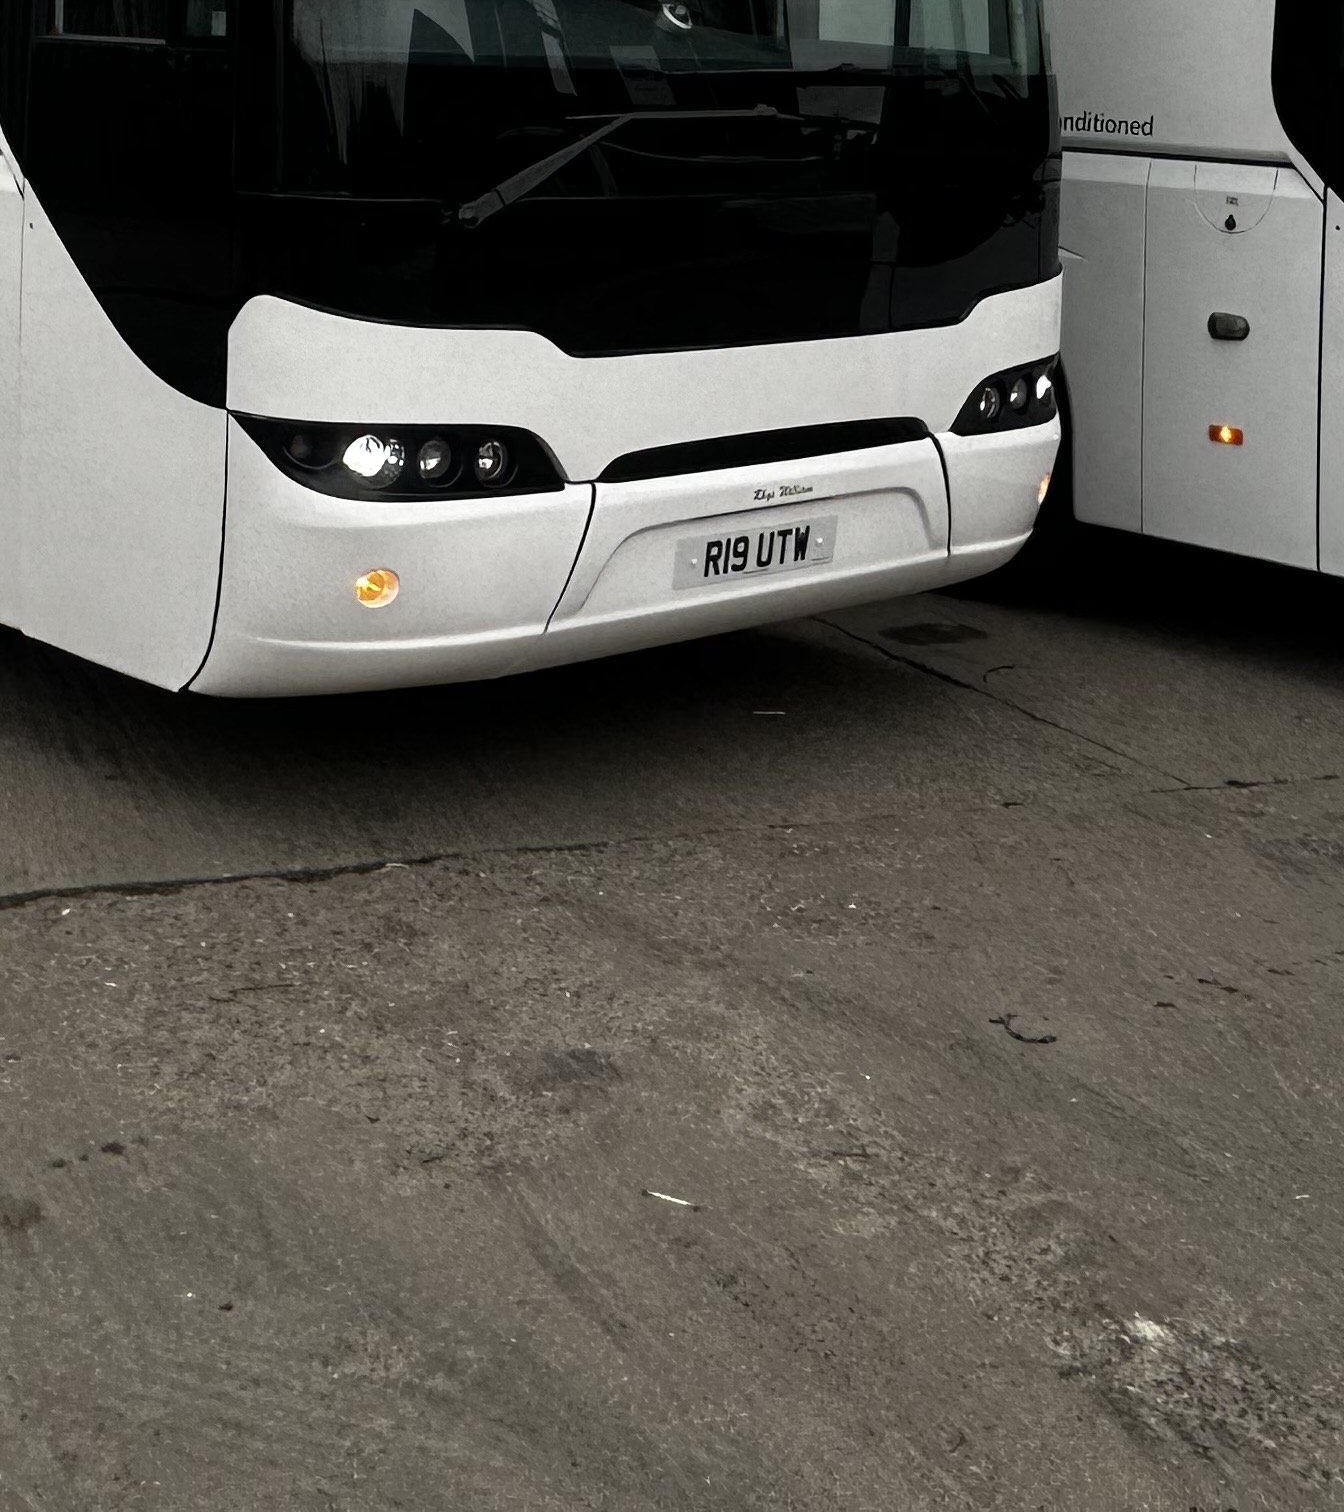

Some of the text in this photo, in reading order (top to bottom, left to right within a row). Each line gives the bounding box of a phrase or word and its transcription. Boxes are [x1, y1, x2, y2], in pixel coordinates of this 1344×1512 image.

[1059, 110, 1154, 137] nditioned
[703, 525, 810, 577] R19 UTW
